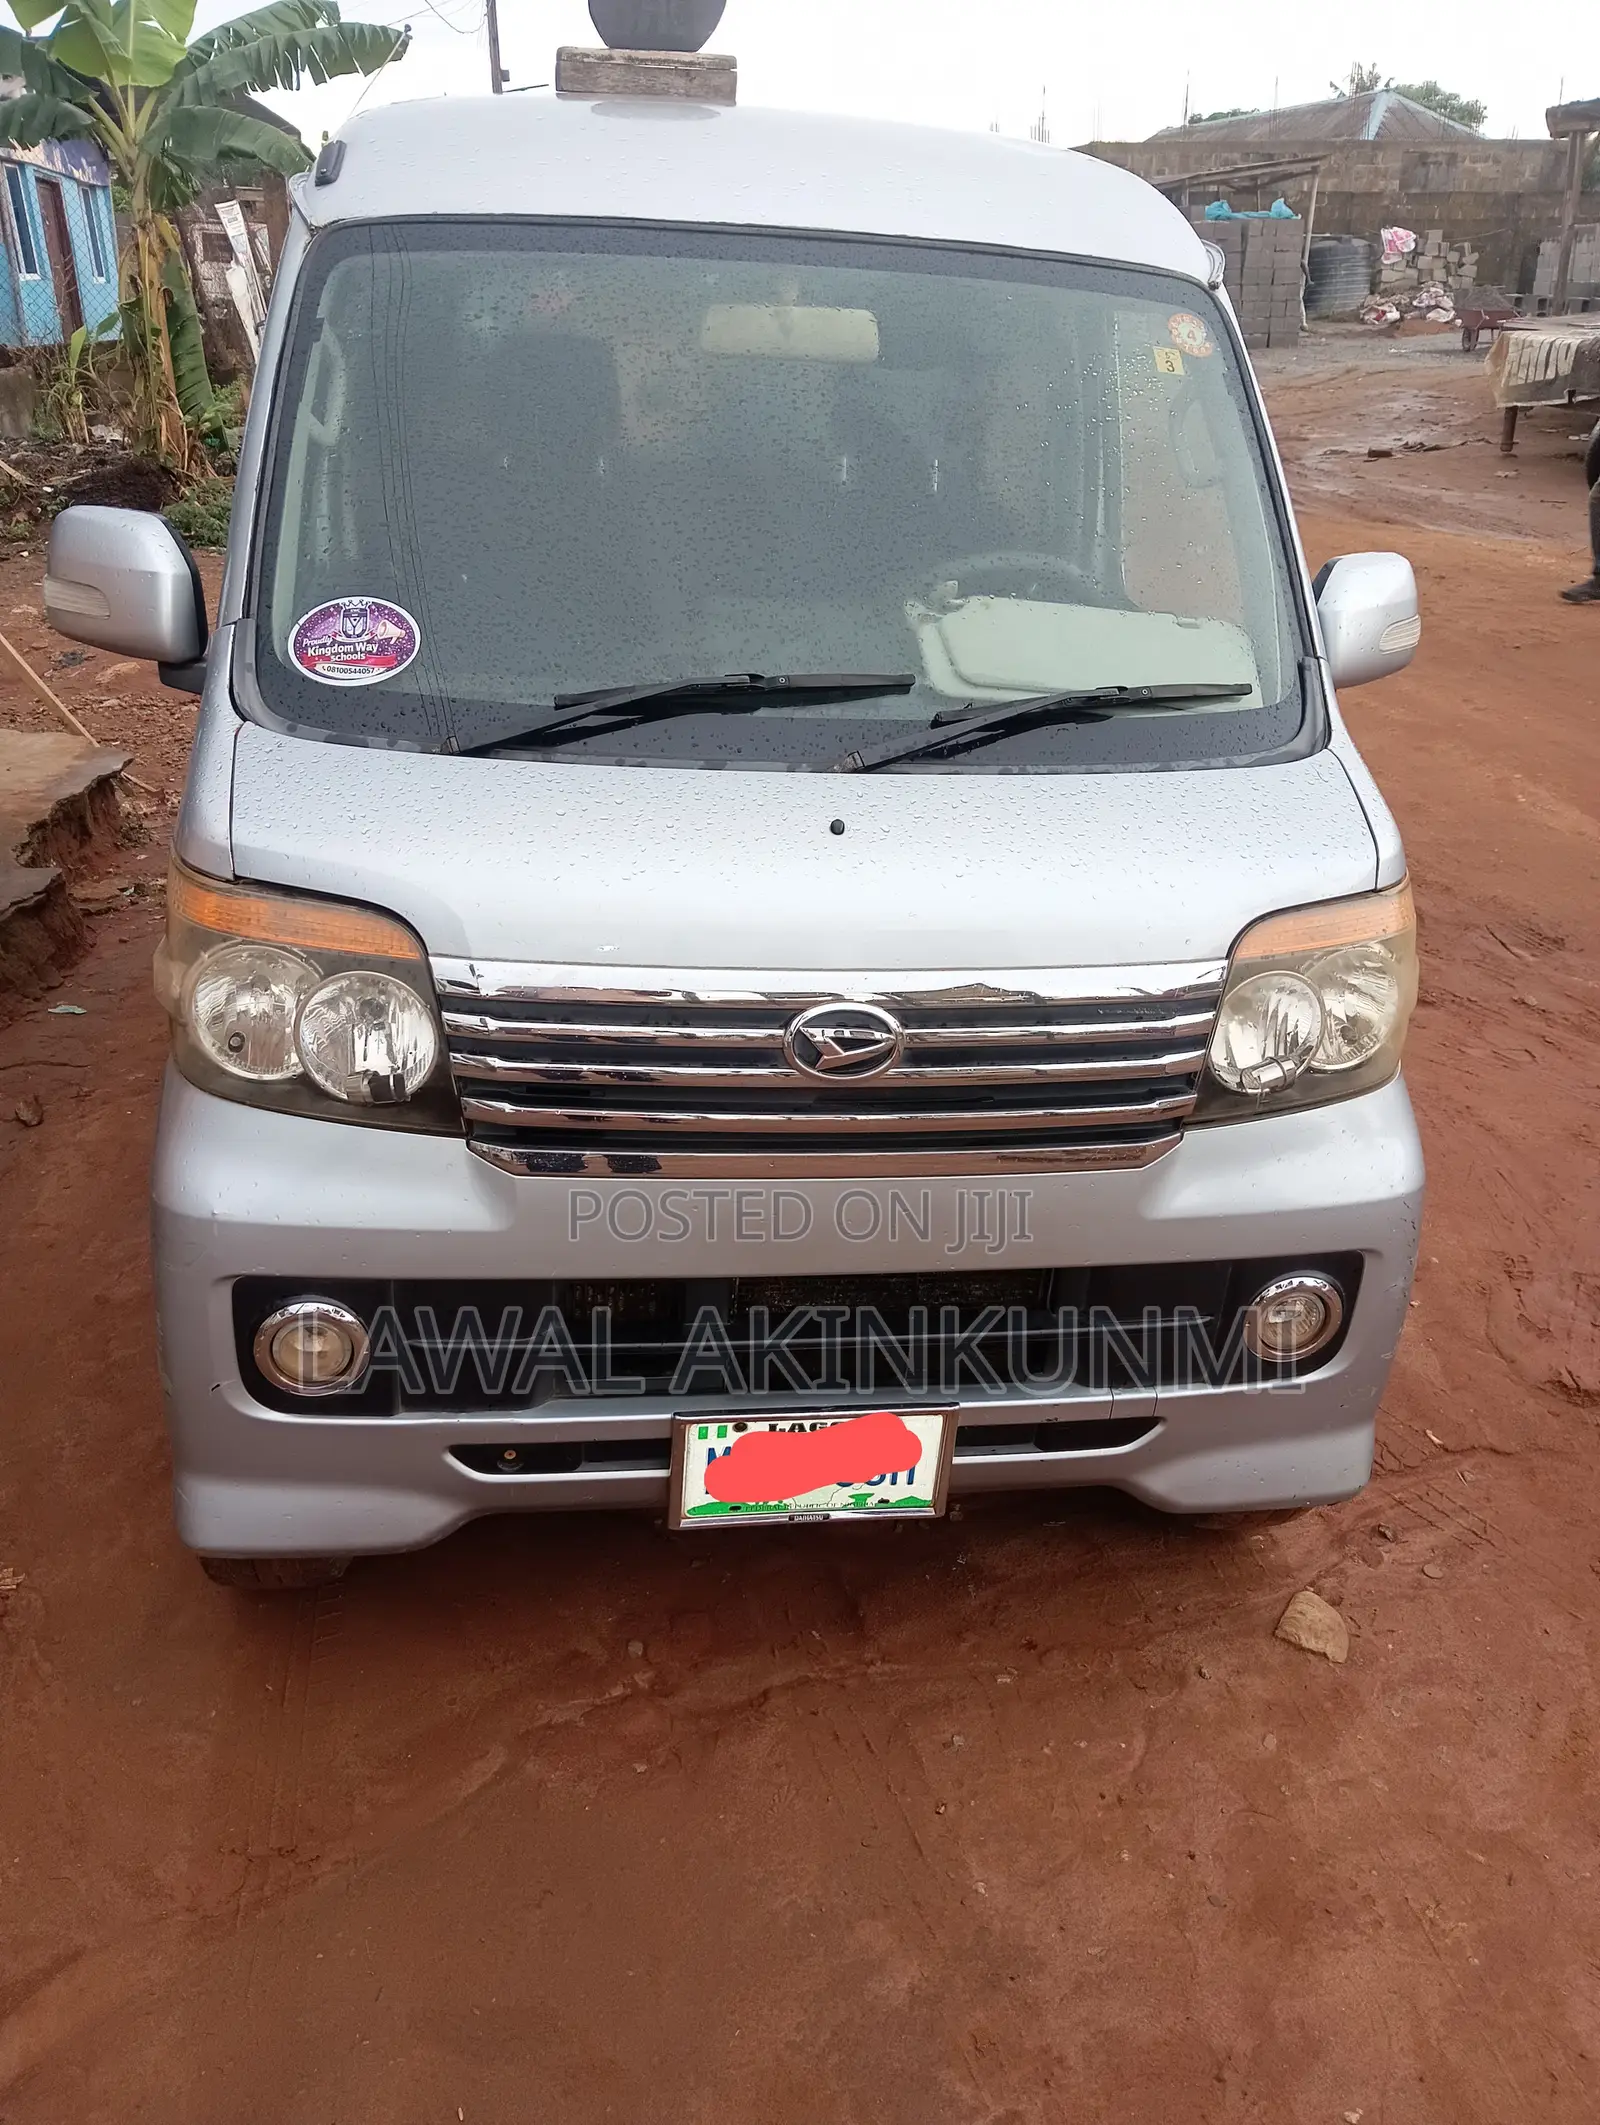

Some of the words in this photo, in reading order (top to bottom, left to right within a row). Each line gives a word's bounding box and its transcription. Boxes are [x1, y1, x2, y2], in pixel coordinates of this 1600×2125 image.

[1165, 360, 1175, 372] 3
[302, 635, 333, 648] Proudly
[307, 643, 354, 658] Kingdom
[355, 641, 379, 653] Way
[326, 665, 375, 675] 08100544057
